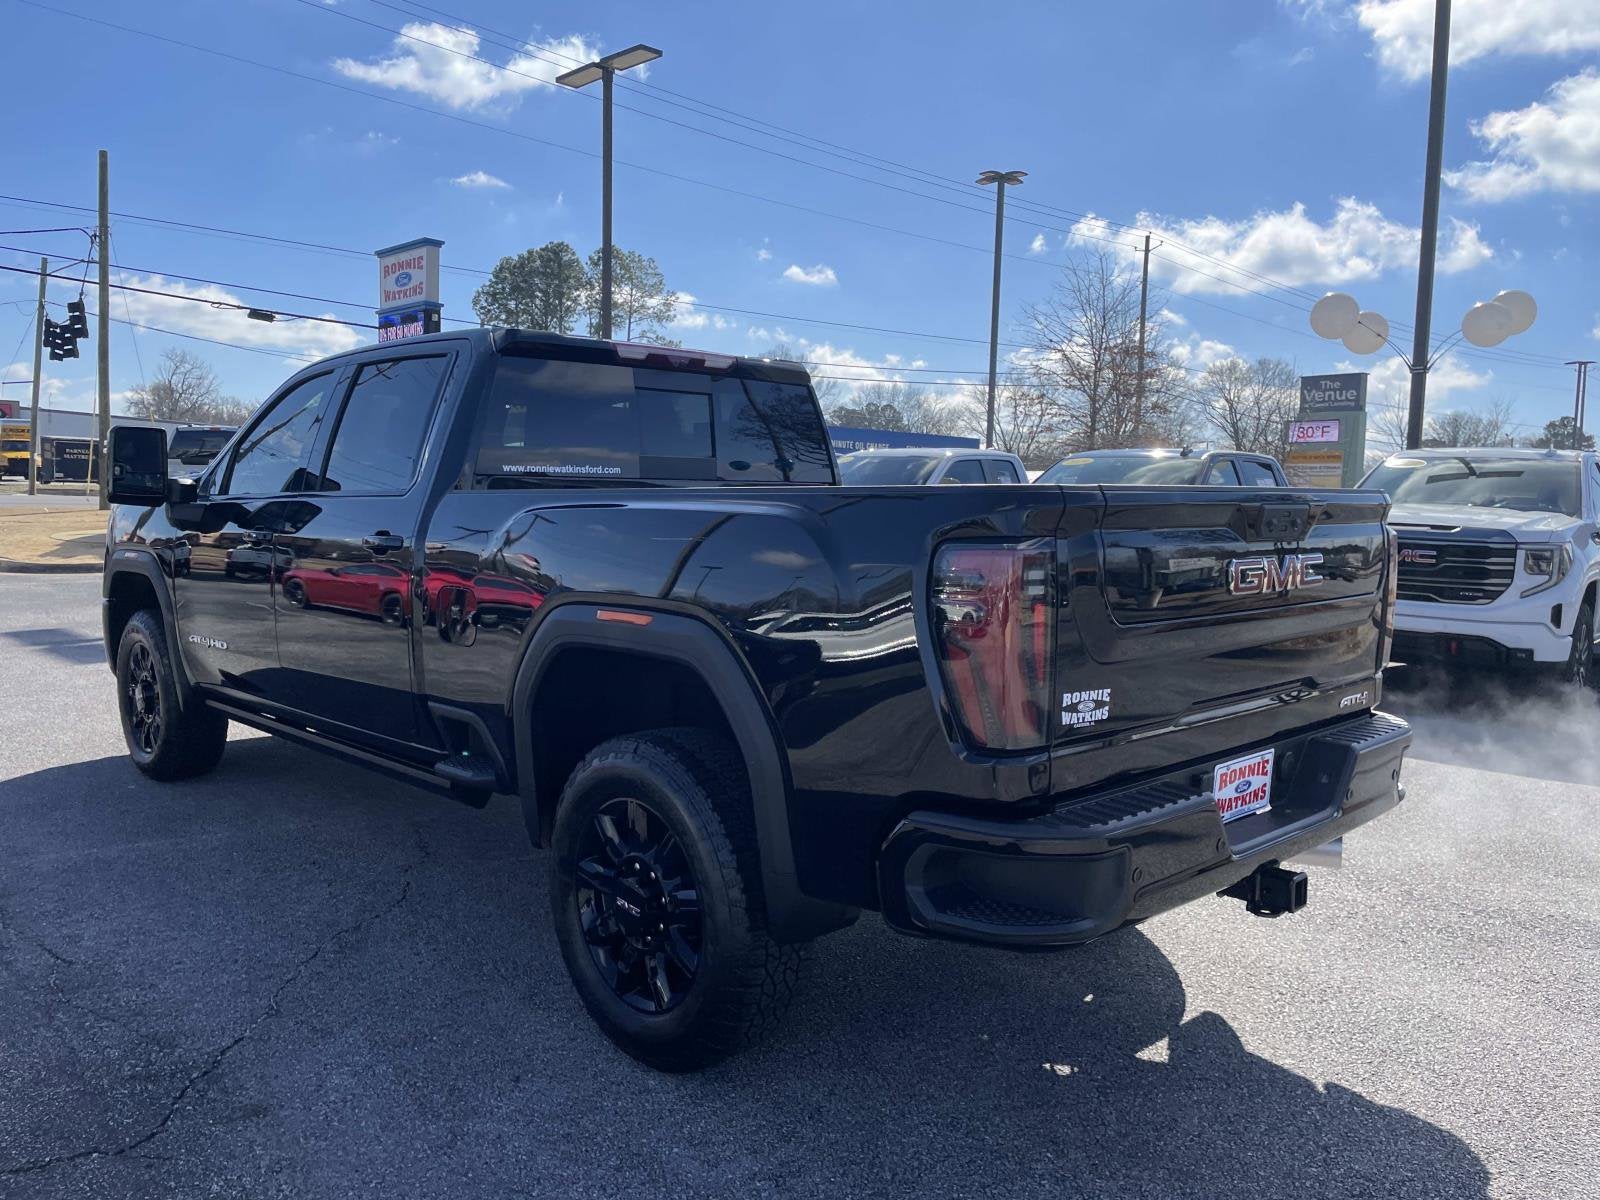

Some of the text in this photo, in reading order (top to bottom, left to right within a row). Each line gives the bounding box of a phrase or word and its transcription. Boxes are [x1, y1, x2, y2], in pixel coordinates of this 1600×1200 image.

[384, 256, 424, 279] RONNIE
[384, 282, 424, 303] WATKINS
[388, 326, 396, 341] FOR
[397, 325, 404, 340] 60
[404, 321, 424, 338] MONTHS
[1320, 380, 1342, 390] The
[1304, 389, 1358, 402] Venue
[832, 439, 853, 449] MINUTE
[855, 441, 865, 450] OIL
[503, 464, 621, 474] www.ronniewatkinsford.com
[1229, 553, 1324, 595] GMC
[1062, 688, 1111, 707] RONNIE
[1062, 706, 1109, 725] WATKINS
[1218, 759, 1270, 792] RONNIE
[1216, 783, 1268, 814] WATKINS
